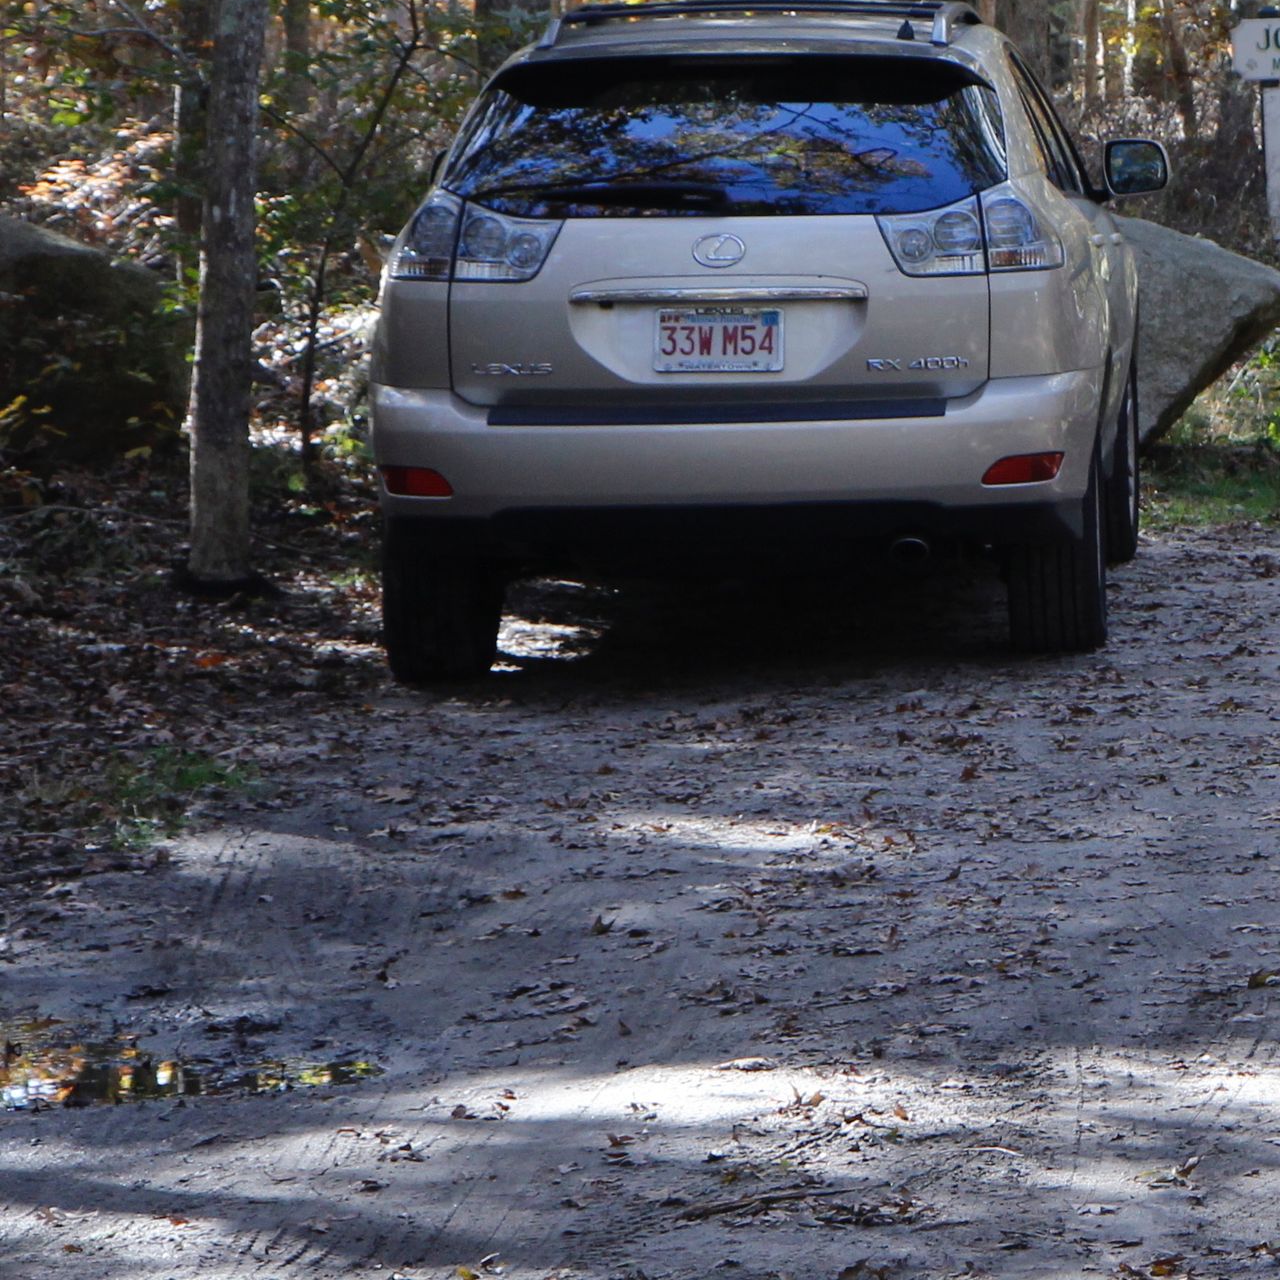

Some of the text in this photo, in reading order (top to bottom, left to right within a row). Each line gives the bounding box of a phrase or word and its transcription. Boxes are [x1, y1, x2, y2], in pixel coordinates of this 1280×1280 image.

[661, 325, 773, 356] 33W M54
[471, 362, 553, 376] LEXUS
[866, 355, 969, 372] RX 400h
